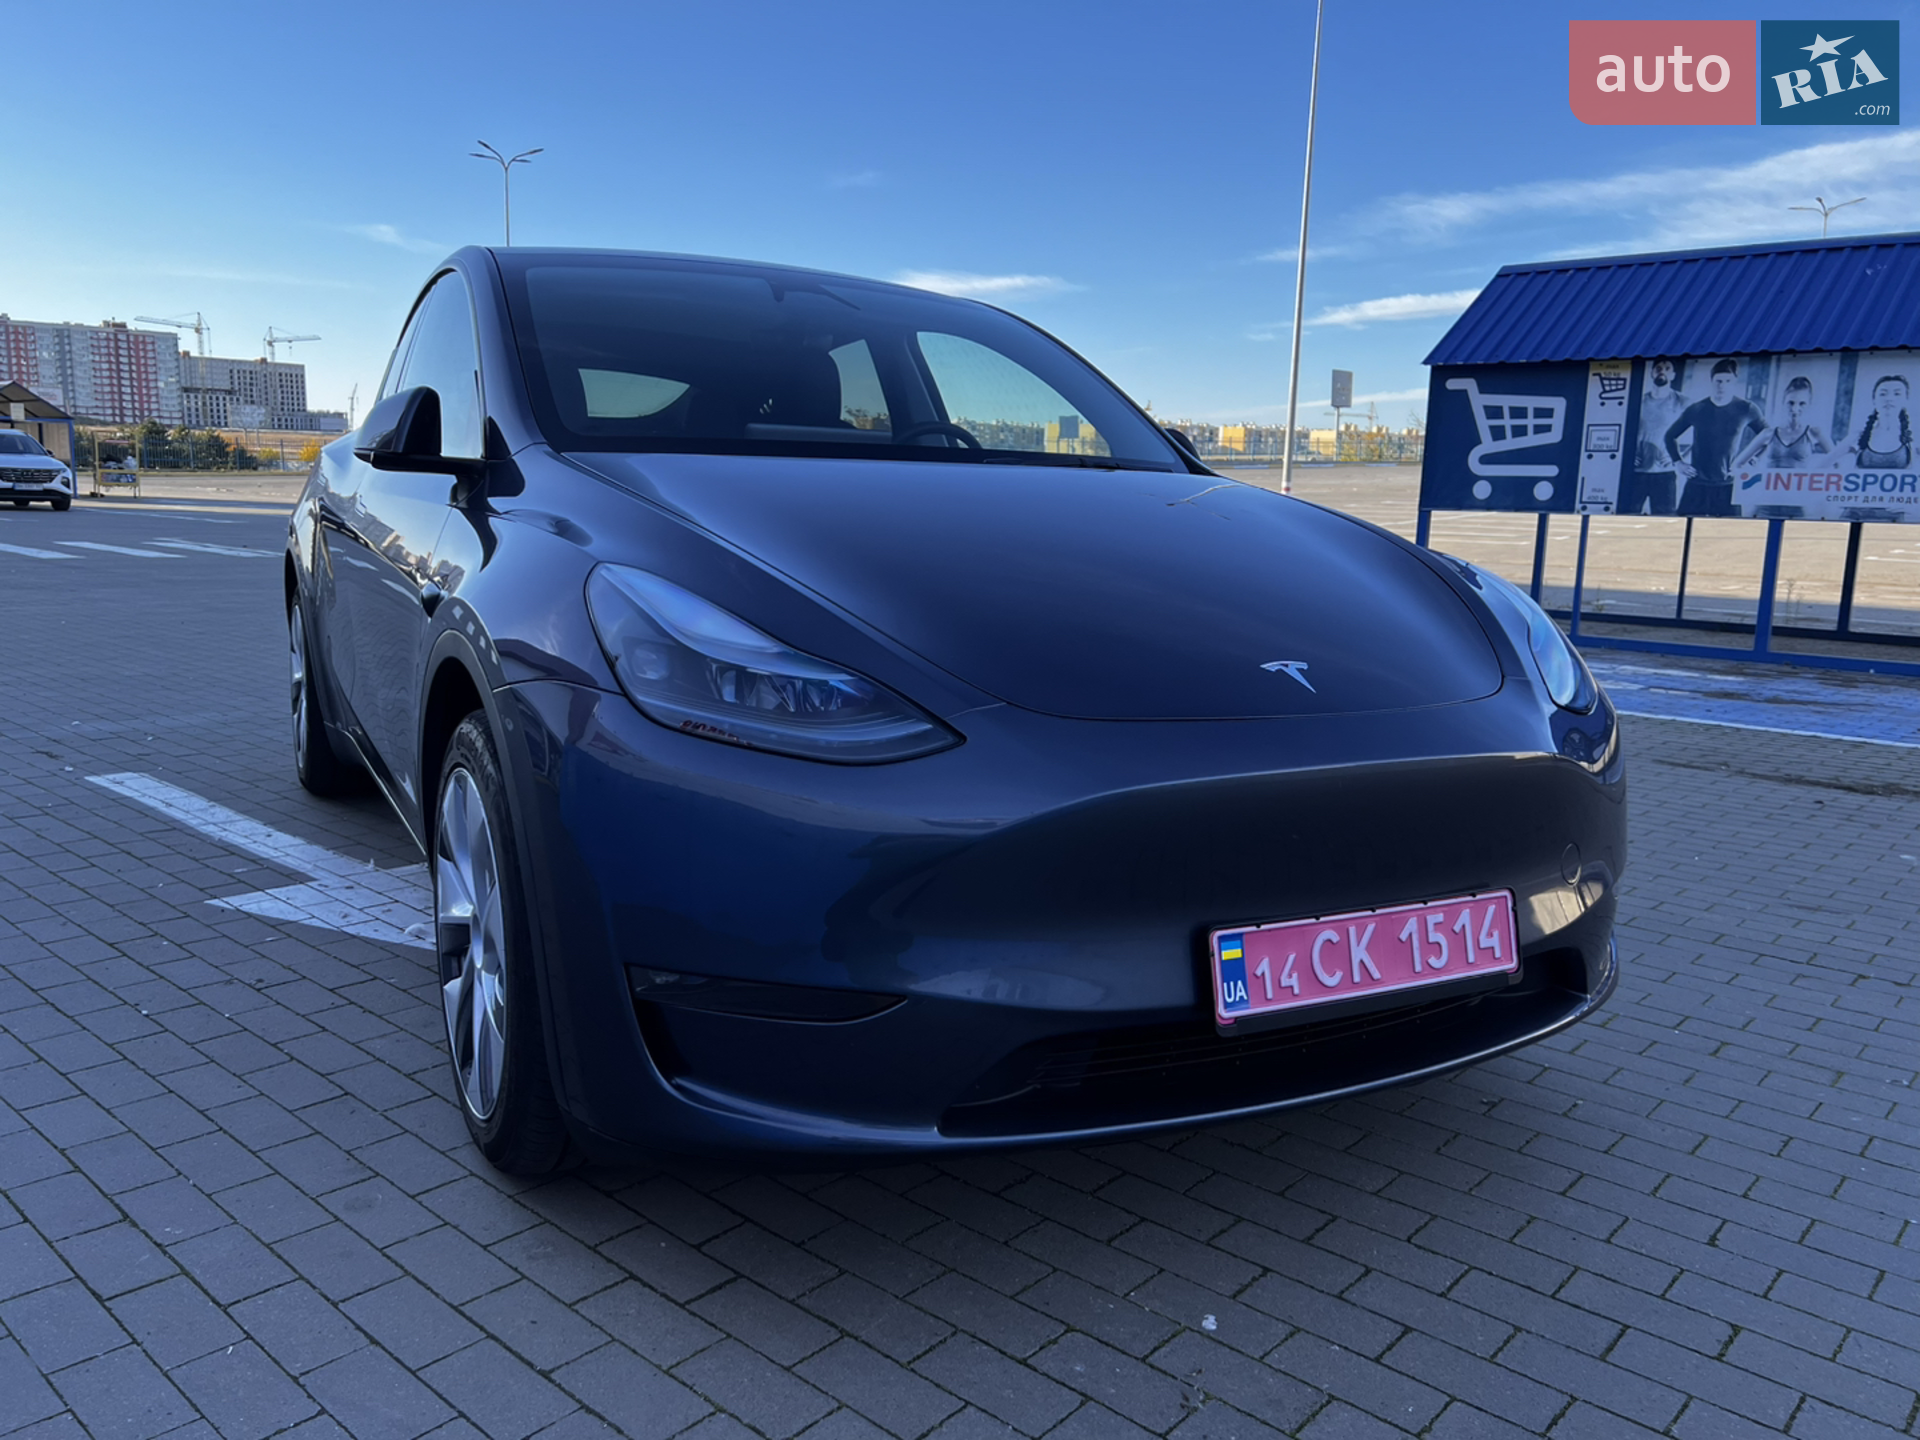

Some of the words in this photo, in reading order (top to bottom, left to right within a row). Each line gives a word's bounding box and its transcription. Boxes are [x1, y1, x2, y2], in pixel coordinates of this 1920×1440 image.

[1765, 472, 1920, 493] INTERSPOR
[1826, 495, 1859, 503] СПОРТ
[1862, 495, 1885, 504] ДЛЯ
[1253, 952, 1300, 1000] 14
[1311, 922, 1381, 988] CK
[1398, 903, 1502, 974] 1514
[1223, 980, 1248, 1004] UA
